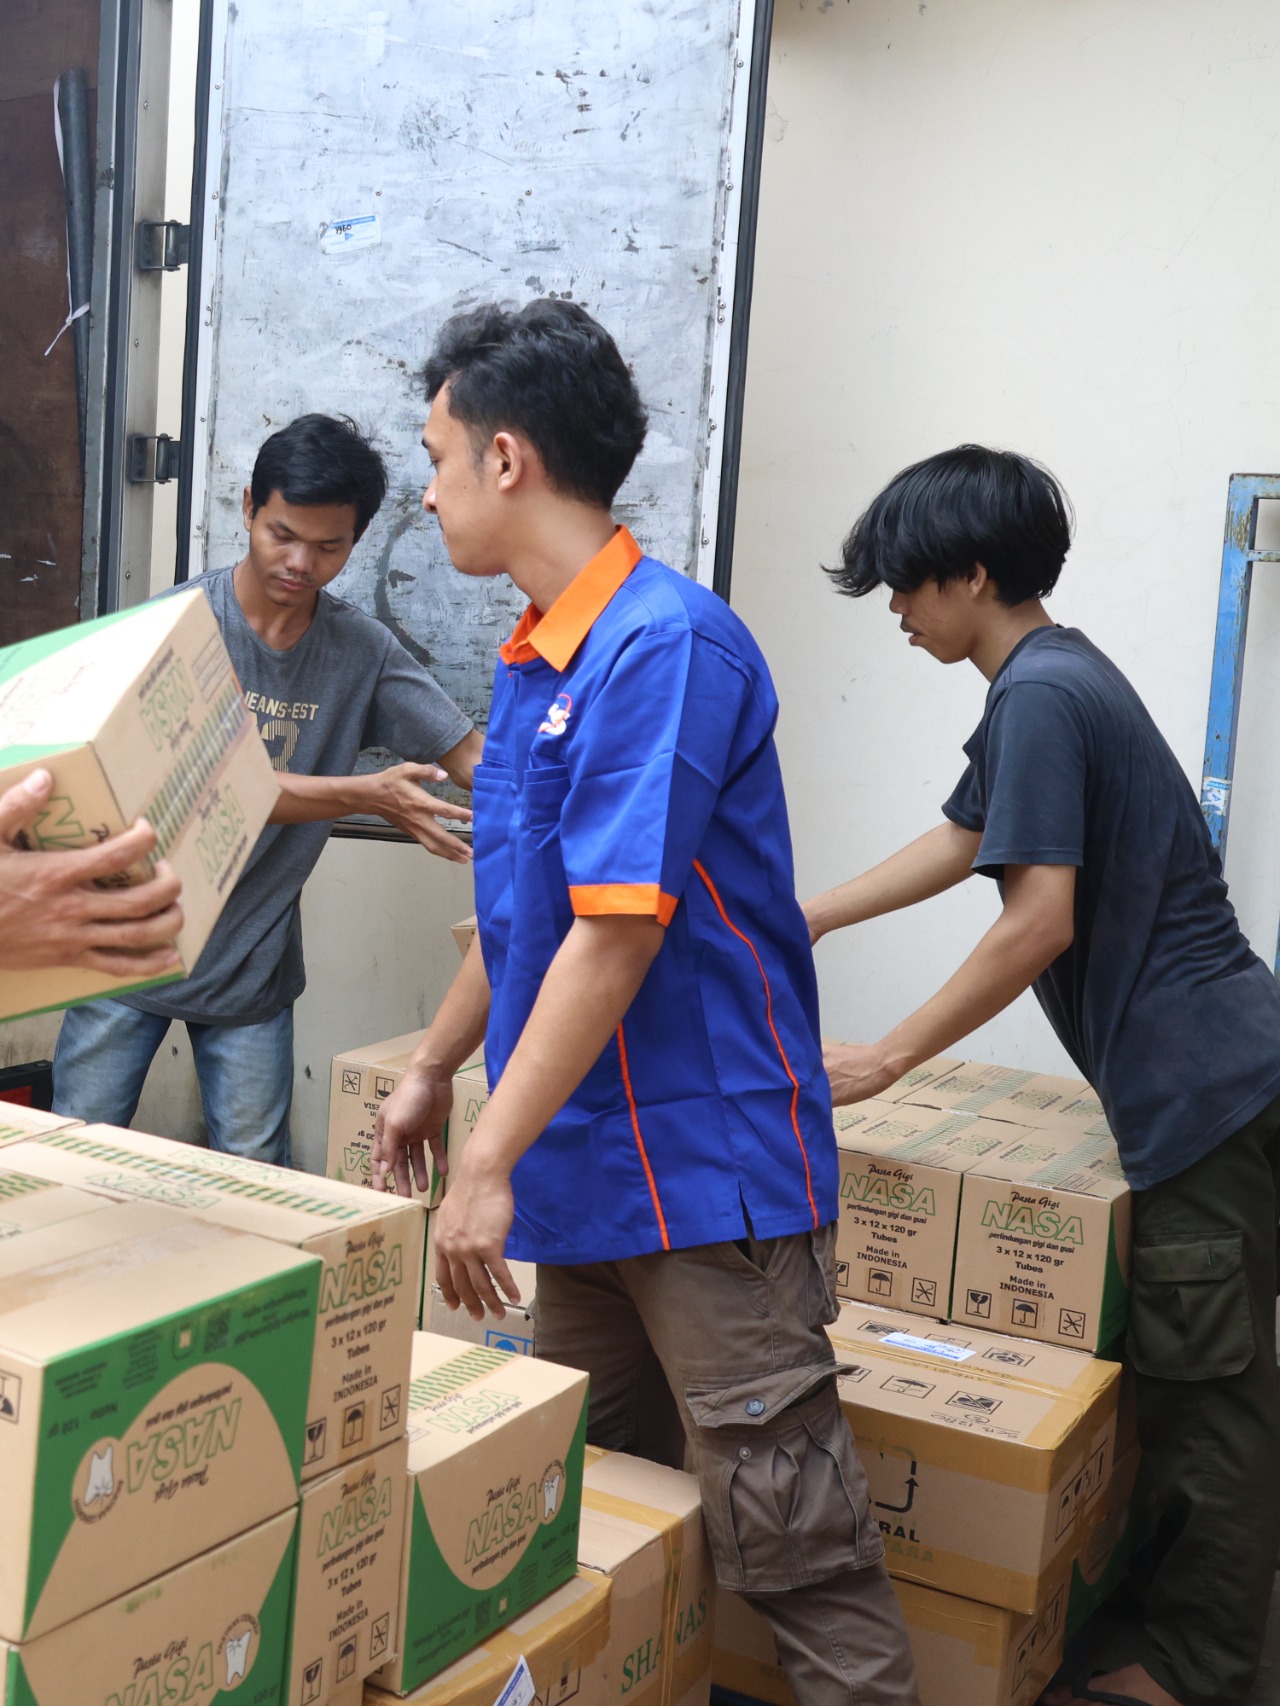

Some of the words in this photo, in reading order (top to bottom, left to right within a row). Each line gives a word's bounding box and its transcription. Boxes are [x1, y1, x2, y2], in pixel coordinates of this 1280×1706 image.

[867, 1163, 892, 1181] Pasta
[893, 1168, 914, 1182] Gigi
[840, 1172, 936, 1216] NASA
[1010, 1191, 1036, 1207] Pasta
[1038, 1196, 1060, 1210] Gigi
[847, 1203, 886, 1219] perlindungan
[887, 1210, 899, 1222] gigi
[901, 1213, 912, 1223] dan
[913, 1216, 927, 1226] gusi
[981, 1200, 1084, 1245] NASA
[853, 1217, 860, 1225] 3
[861, 1219, 868, 1227] x
[869, 1219, 880, 1230] 12
[881, 1223, 888, 1231] x
[890, 1224, 906, 1235] 120
[908, 1228, 918, 1238] gr
[871, 1231, 898, 1245] Tubes
[344, 1238, 367, 1258] Pasta
[866, 1245, 887, 1257] Made
[890, 1249, 900, 1259] in
[988, 1231, 1031, 1248] perlindungan
[1032, 1239, 1046, 1250] gigi
[1047, 1241, 1058, 1252] dan
[1060, 1245, 1075, 1255] gusi
[857, 1251, 908, 1270] INDONESIA
[996, 1246, 1003, 1255] 3
[1013, 1250, 1025, 1259] 12
[1035, 1254, 1052, 1266] 120
[1054, 1258, 1065, 1267] gr
[1015, 1261, 1044, 1274] Tubes
[318, 1244, 403, 1314] NASA
[1010, 1275, 1033, 1288] Made
[1035, 1279, 1046, 1290] in
[999, 1282, 1055, 1301] INDONESIA
[331, 1336, 337, 1348] 3
[338, 1334, 344, 1345] x
[346, 1328, 355, 1343] 12
[356, 1327, 361, 1339] x
[363, 1322, 377, 1336] 120
[378, 1318, 387, 1331] gr
[347, 1343, 370, 1360] Tubes
[342, 1368, 362, 1385] Made
[365, 1365, 372, 1377] in
[333, 1375, 378, 1403] INDONESIA
[426, 1389, 519, 1434] NASA
[127, 1398, 242, 1495] NASA
[316, 1477, 392, 1558] NASA
[464, 1482, 537, 1565] NASA
[341, 1579, 362, 1597] Tubes
[336, 1605, 355, 1623] Made
[356, 1599, 364, 1612] in
[328, 1607, 369, 1643] INDONESIA
[134, 1651, 162, 1679] Pasta
